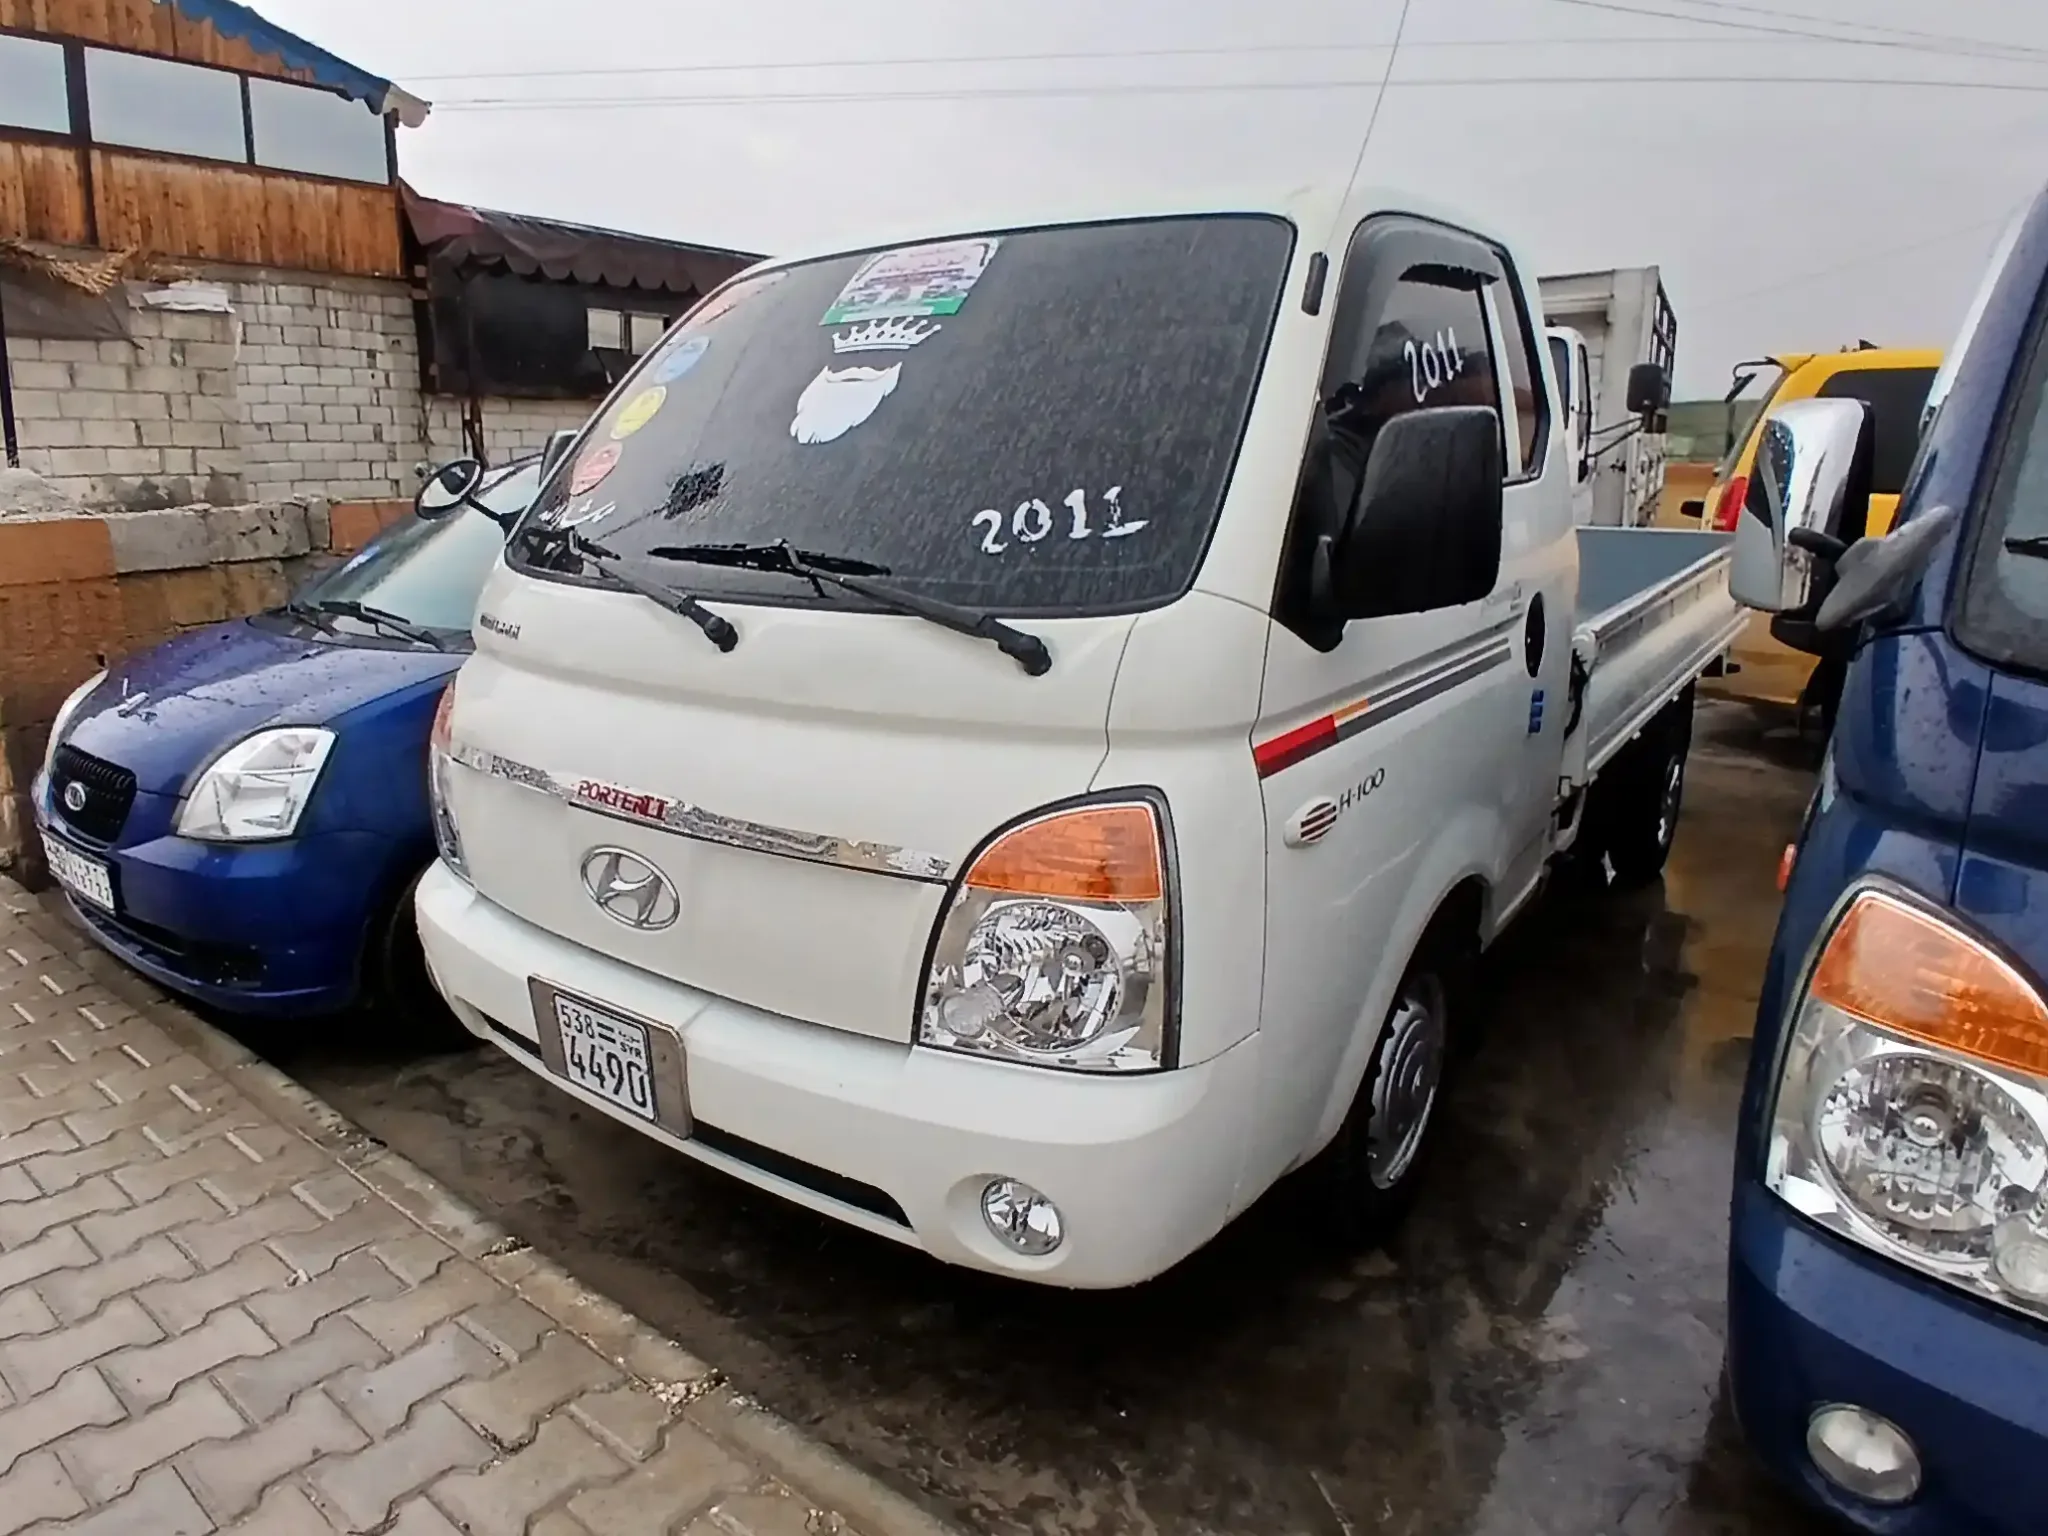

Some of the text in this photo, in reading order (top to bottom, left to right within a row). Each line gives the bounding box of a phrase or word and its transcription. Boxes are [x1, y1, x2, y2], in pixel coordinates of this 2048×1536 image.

[1404, 326, 1463, 403] 2011
[972, 486, 1150, 554] 2011
[1339, 767, 1385, 813] H-100
[560, 1004, 595, 1039] 538
[569, 1035, 648, 1108] 4490
[619, 1041, 643, 1060] SYR
